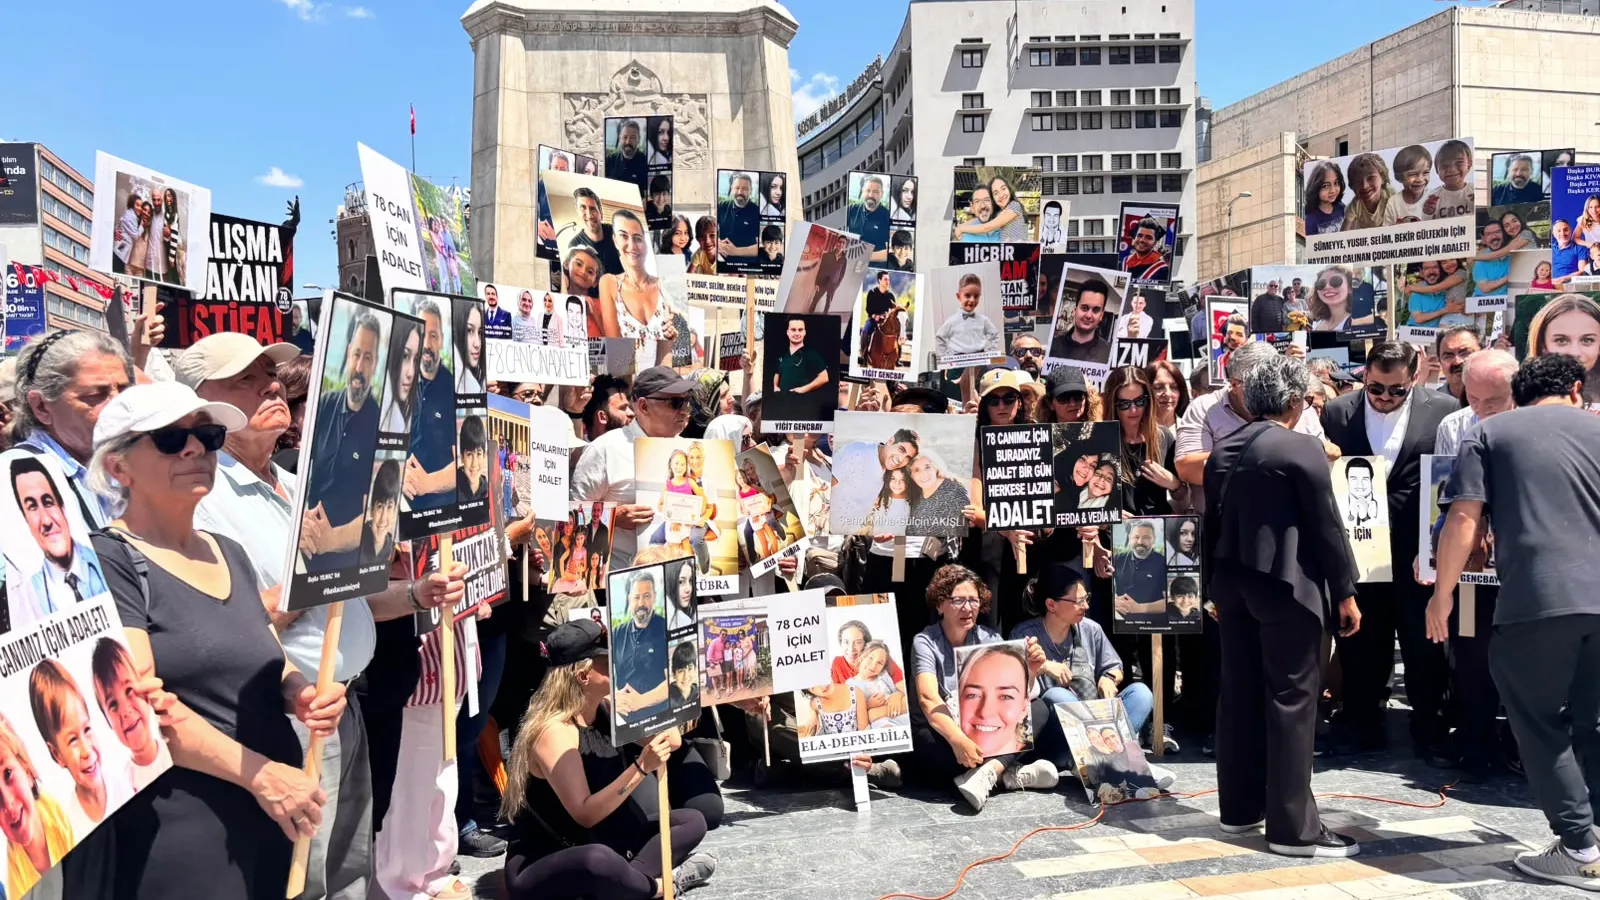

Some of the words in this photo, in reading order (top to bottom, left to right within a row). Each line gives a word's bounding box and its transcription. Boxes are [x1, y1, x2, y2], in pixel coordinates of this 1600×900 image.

[373, 192, 387, 212] 78
[387, 201, 411, 224] CAN
[385, 221, 408, 248] İÇİN
[1313, 239, 1346, 252] SÜMEYYE,
[1346, 236, 1370, 249] YUSUF,
[1370, 232, 1394, 246] SELİM,
[1394, 229, 1415, 244] BEKİR
[1416, 225, 1450, 241] GÜLTEKİN
[1450, 224, 1466, 239] İÇİN
[1371, 245, 1424, 263] ÇOCUKLARIMIZ
[1424, 243, 1440, 256] İÇİN
[1441, 240, 1471, 254] ADALET!
[382, 249, 422, 278] ADALET
[196, 261, 282, 303] AKANI
[279, 290, 288, 300] 78
[1477, 297, 1505, 308] ATAKAN
[1410, 328, 1436, 338] ATAKAN
[774, 421, 793, 431] YİĞİT
[985, 431, 997, 446] 78
[997, 430, 1032, 445] CANIMIZ
[1032, 427, 1050, 446] İÇİN
[531, 441, 568, 457] CANLARIMIZ
[995, 447, 1042, 463] BURADAYIZ
[543, 457, 557, 471] İÇİN
[986, 466, 1018, 481] ADALET
[1018, 462, 1034, 478] BİR
[1033, 461, 1053, 478] GÜN
[538, 474, 562, 486] ADALET
[988, 483, 1027, 498] HERKESE
[1026, 481, 1052, 496] LAZIM
[987, 499, 1055, 528] ADALET
[1056, 512, 1081, 525] FERDA
[1081, 511, 1087, 524] &
[1087, 508, 1109, 523] VEDİA
[1109, 507, 1121, 522] NİL
[1353, 526, 1373, 542] İÇİN
[763, 557, 777, 571] ALYA
[466, 563, 507, 607] DEĞİLDİR!
[38, 618, 71, 659] İÇİN
[66, 604, 111, 645] ADALET!
[775, 619, 791, 632] 78
[793, 615, 820, 628] CAN
[786, 633, 812, 649] İÇİN
[775, 650, 826, 668] ADALET
[801, 728, 910, 753] ELA-DEFNE-DİLA
